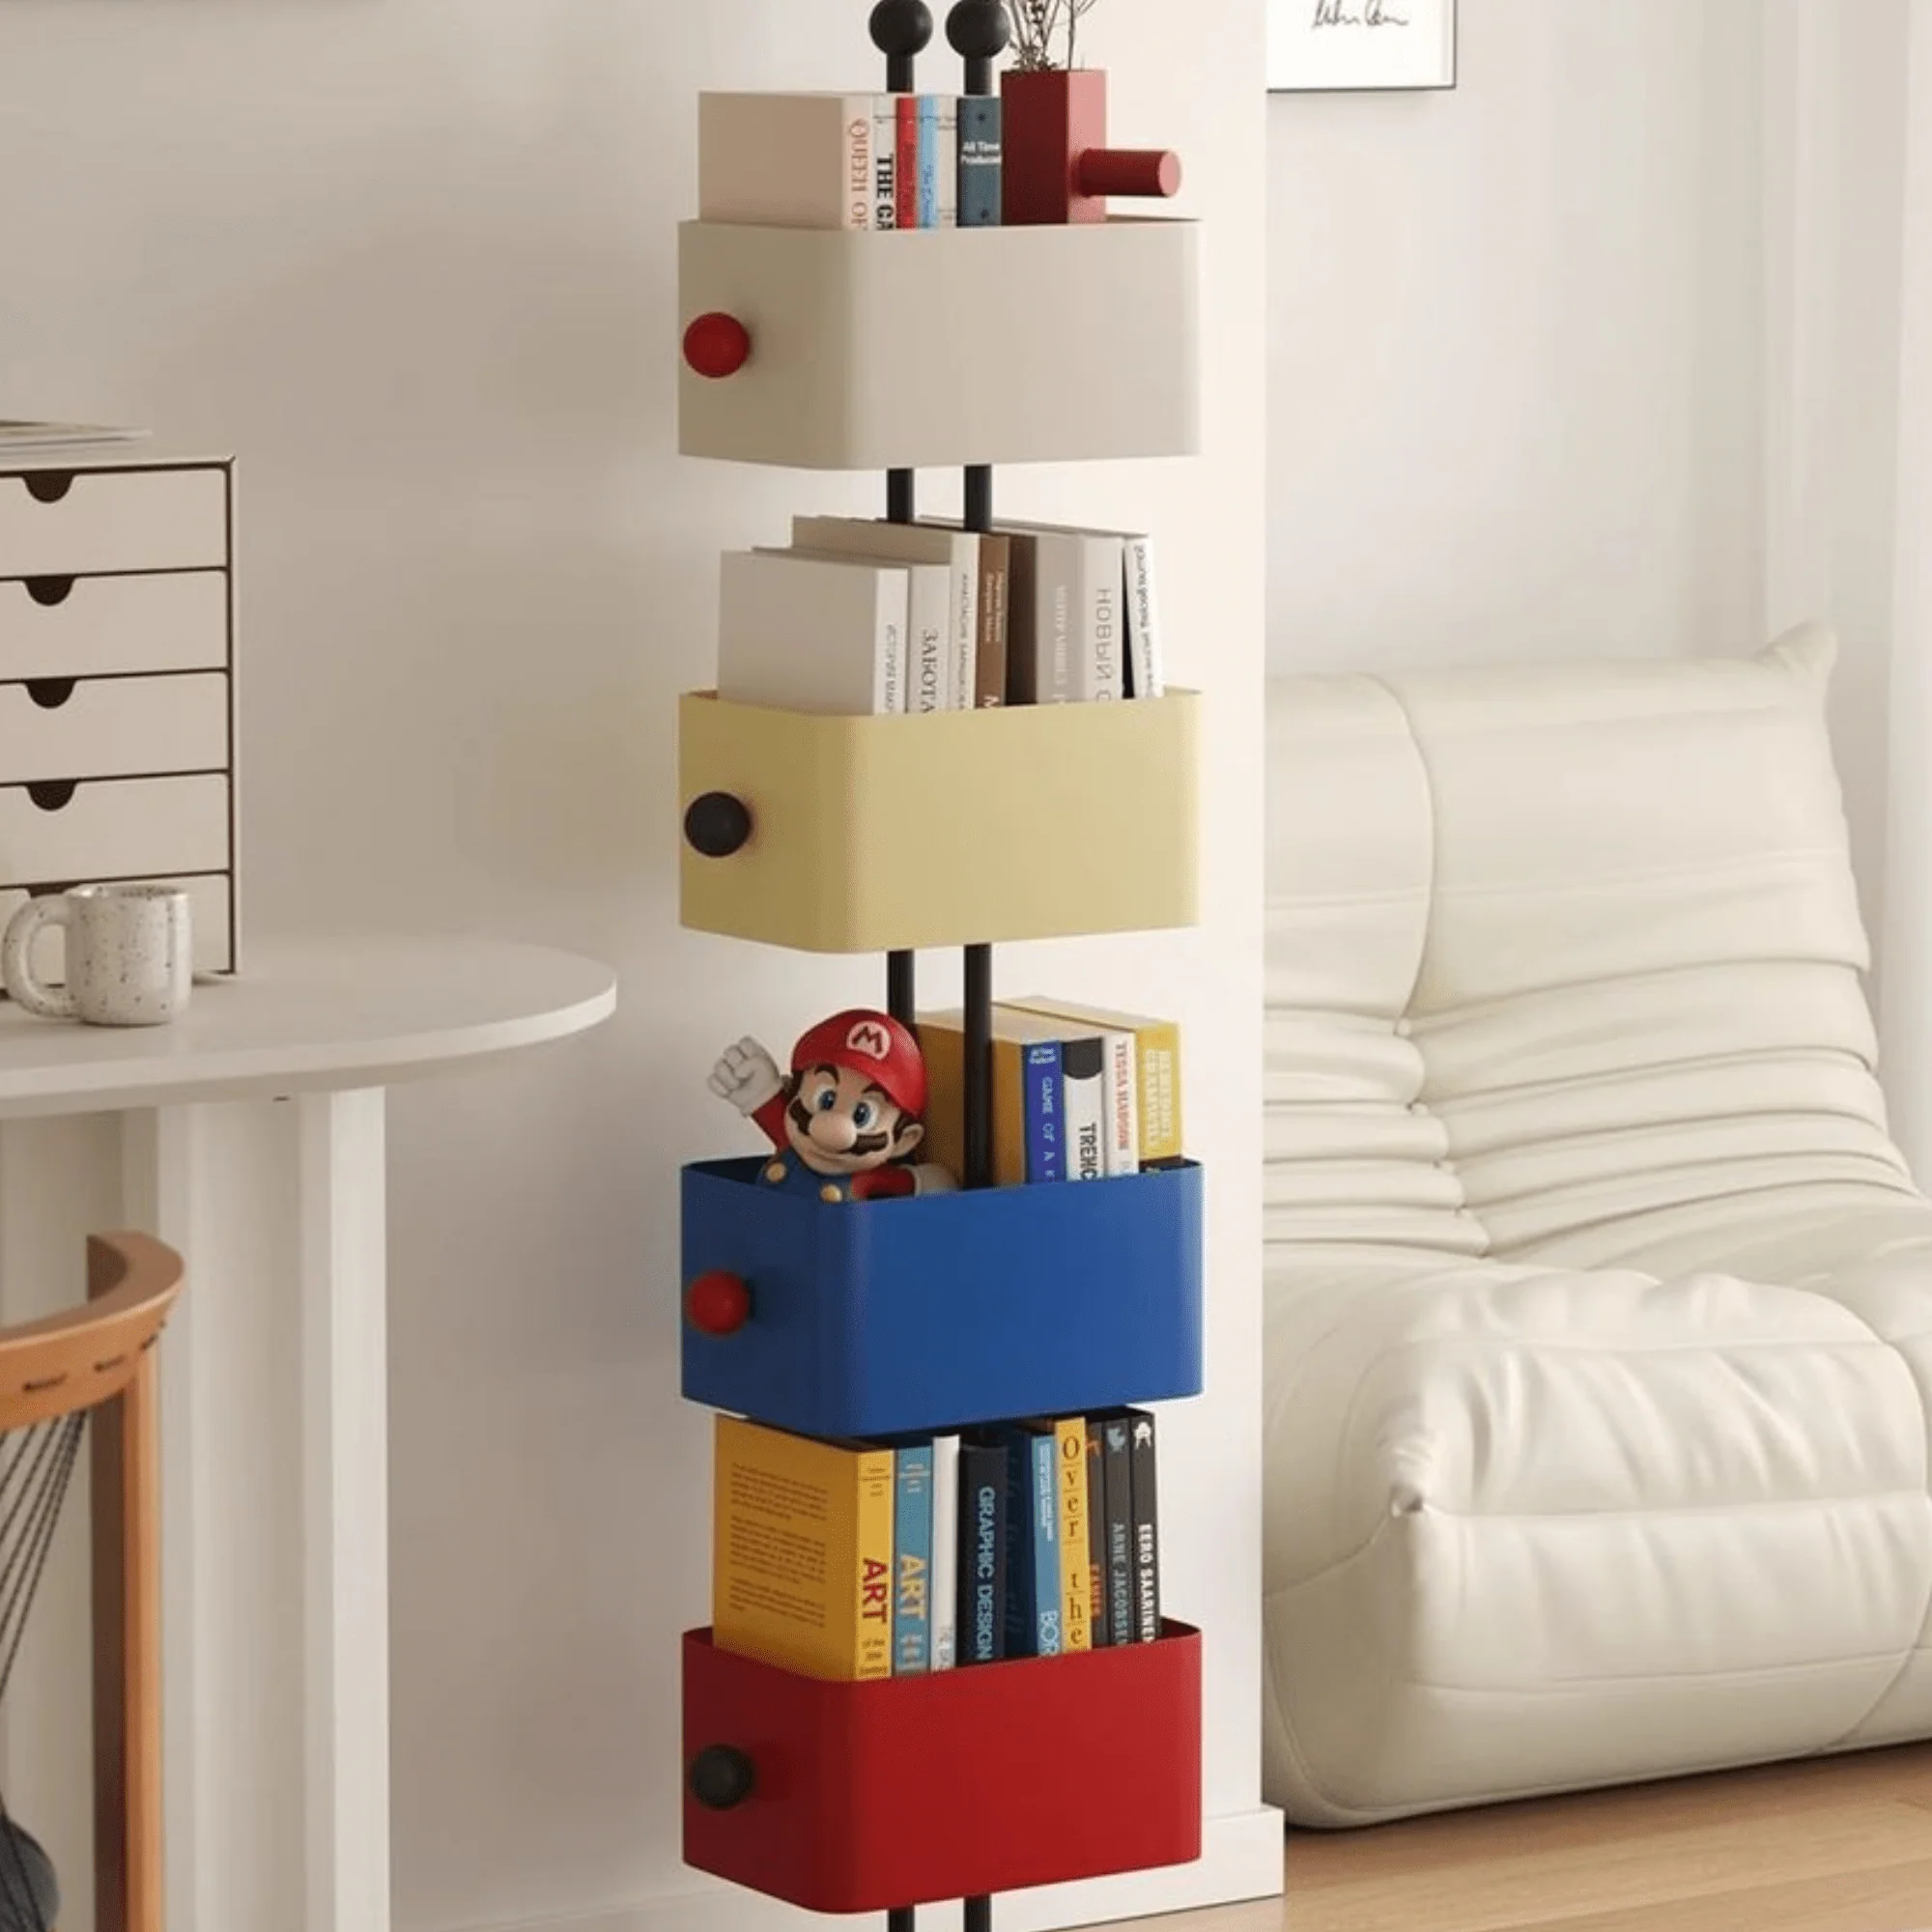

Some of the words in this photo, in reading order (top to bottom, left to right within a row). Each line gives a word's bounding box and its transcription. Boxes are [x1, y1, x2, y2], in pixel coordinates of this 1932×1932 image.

[849, 118, 868, 191] QUEEN
[876, 154, 894, 198] THE
[1094, 589, 1113, 679] НОВЫЙ
[921, 629, 938, 713] ЗАБОТА
[851, 1025, 883, 1054] M
[1063, 1435, 1081, 1537] Over
[978, 1486, 995, 1579] GRAPHIC
[1113, 1522, 1127, 1564] ARNE
[1138, 1523, 1153, 1563] EERO
[862, 1557, 889, 1624] ART
[899, 1553, 927, 1620] ART
[976, 1583, 994, 1660] DESIGN
[1068, 1572, 1084, 1645] the
